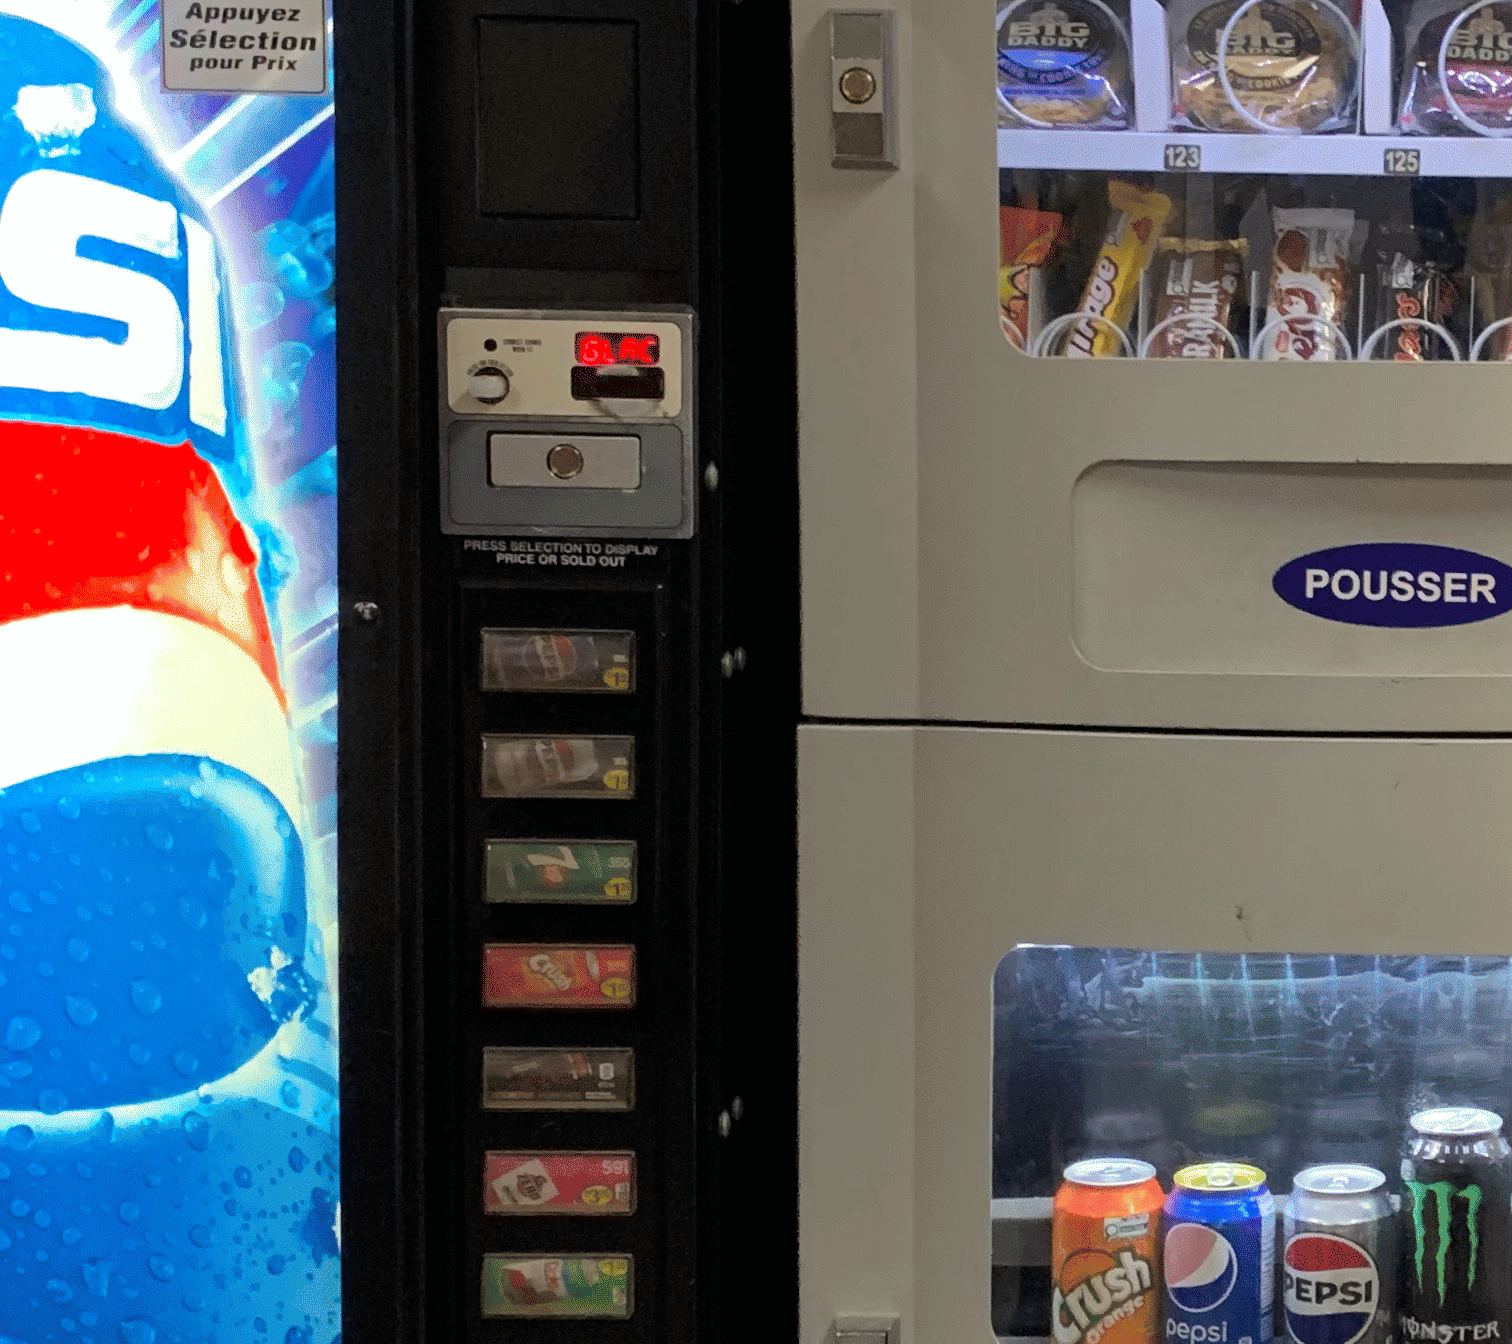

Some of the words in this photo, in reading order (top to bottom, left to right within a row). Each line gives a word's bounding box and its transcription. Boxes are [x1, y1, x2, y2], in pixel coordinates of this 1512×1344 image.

[185, 2, 301, 24] Appuyez
[1009, 20, 1091, 37] BIG
[169, 28, 317, 51] Sélection
[1007, 36, 1088, 49] DADDY
[190, 56, 243, 72] pour
[251, 55, 298, 71] Prix
[1166, 147, 1199, 168] 123
[1385, 151, 1419, 173] 125
[464, 539, 507, 552] PRESS
[510, 541, 584, 554] SELECTION
[586, 542, 601, 554] TO
[605, 543, 659, 556] DISPLAY
[496, 553, 535, 565] PRICE
[539, 554, 558, 565] OR
[560, 554, 597, 566] SOLD
[600, 555, 627, 567] OUT
[1305, 567, 1497, 604] POUSSER
[1284, 1272, 1373, 1306] PEPSI
